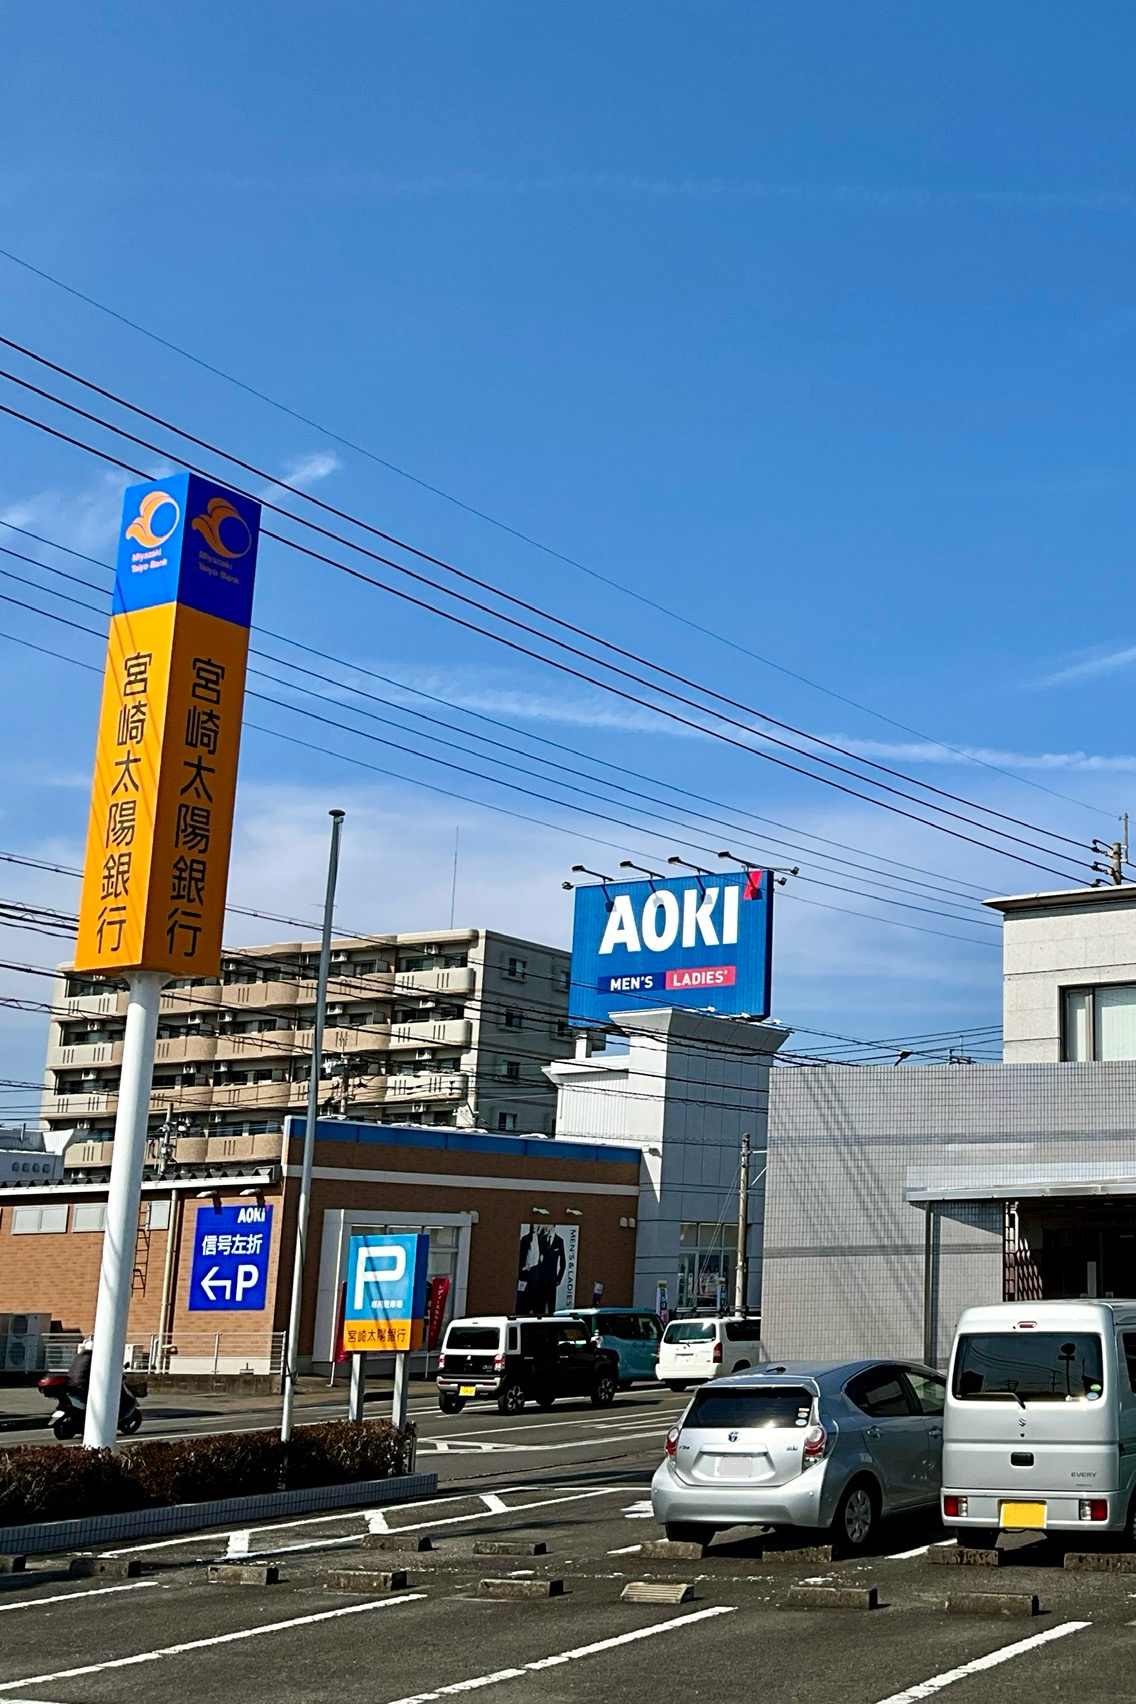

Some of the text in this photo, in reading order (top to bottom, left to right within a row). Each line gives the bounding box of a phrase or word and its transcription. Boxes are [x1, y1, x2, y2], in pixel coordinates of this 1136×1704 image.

[131, 558, 168, 573] Taiyo Bank
[132, 549, 162, 563] Miyazaki
[97, 652, 153, 955] 宮崎太陽銀行
[166, 657, 225, 959] 宮崎太陽銀行
[598, 886, 739, 955] AOKI
[610, 970, 728, 992] MEN'S LADIES'
[202, 1233, 263, 1256] 信号左折
[235, 1264, 259, 1302] P
[353, 1245, 405, 1309] P
[347, 1328, 407, 1344] 宮崎太陽銀行
